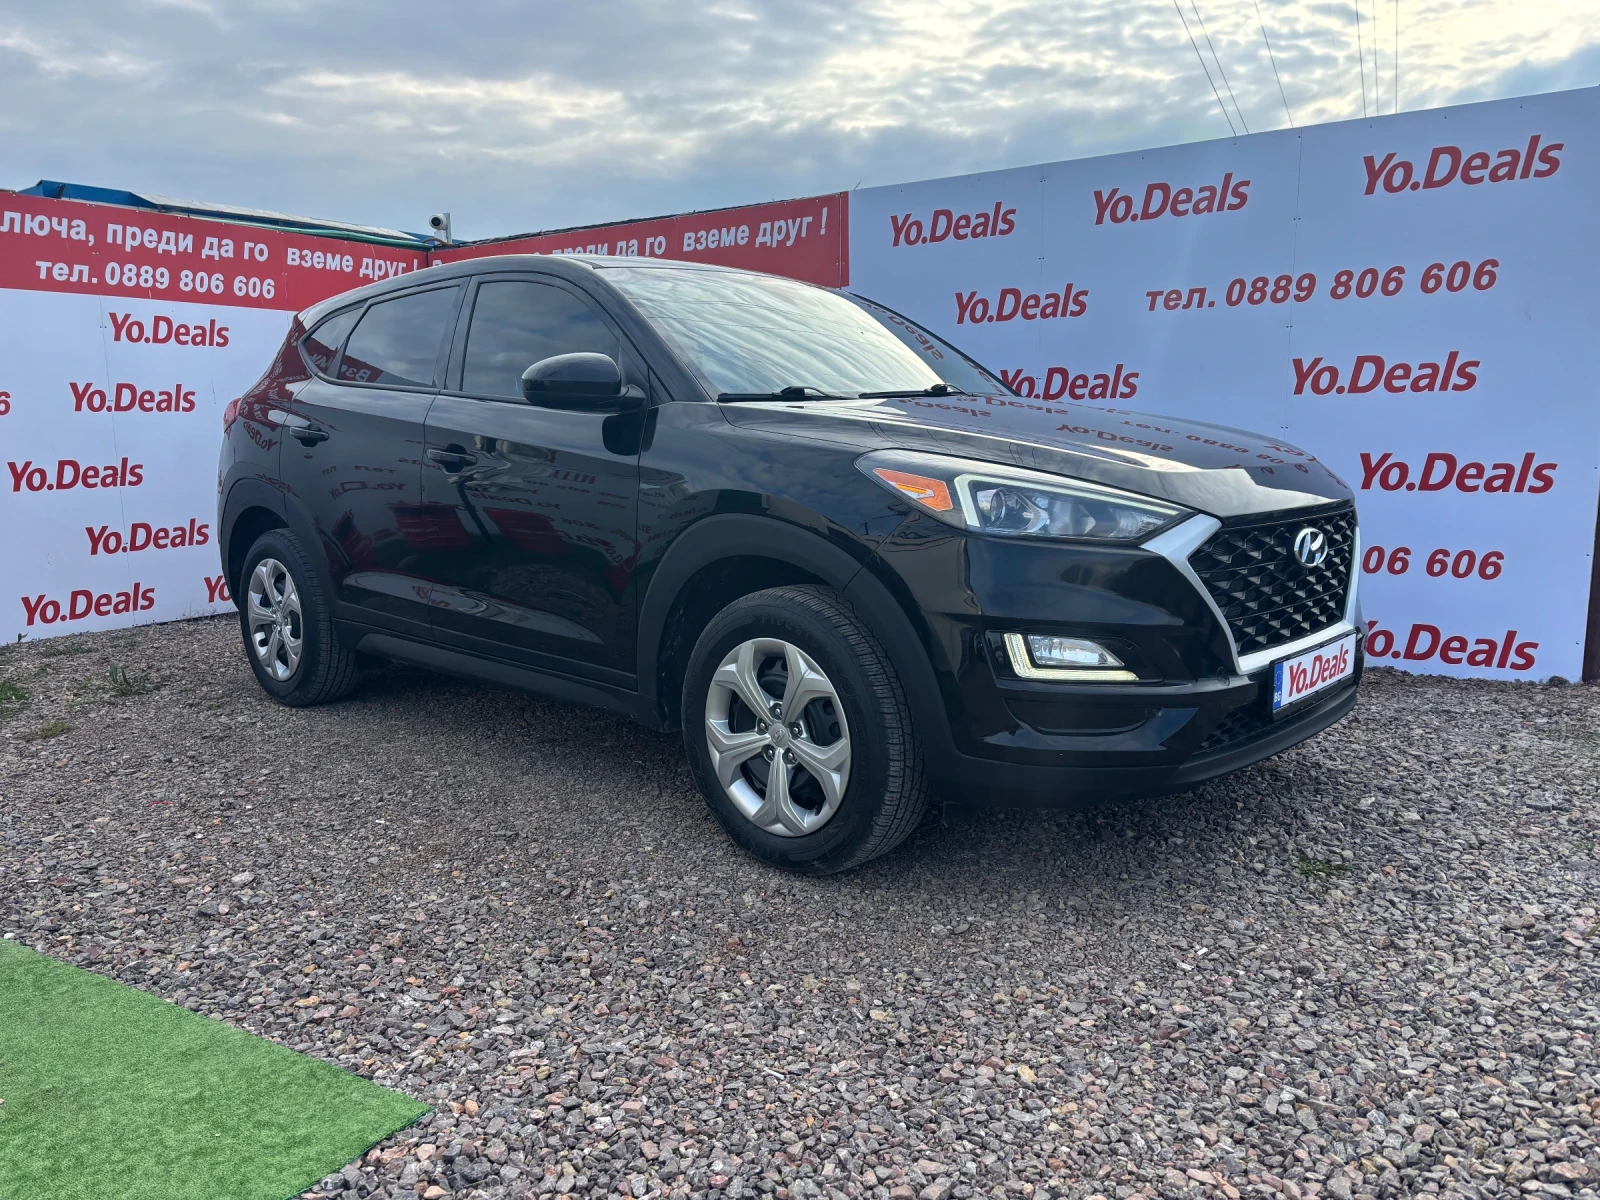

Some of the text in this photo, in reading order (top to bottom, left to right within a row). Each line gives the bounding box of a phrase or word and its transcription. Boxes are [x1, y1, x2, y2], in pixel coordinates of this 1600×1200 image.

[1364, 135, 1563, 195] Yo.Deals
[1094, 174, 1250, 226] Yo.Deals
[645, 235, 667, 256] го
[682, 224, 750, 252] вземе
[755, 216, 813, 248] друг
[820, 207, 828, 235] !
[891, 202, 1016, 247] Yo.Deals
[107, 223, 193, 254] преди
[201, 236, 234, 260] да
[243, 241, 269, 262] го
[287, 247, 354, 273] вземе
[36, 260, 275, 300] тел. 0889 806 606
[1148, 259, 1499, 313] тел. 0889 806 606
[956, 283, 1088, 325] Yo.Deals
[108, 312, 230, 348] Yo.Deals
[1293, 351, 1480, 397] Yo.Deals
[69, 382, 196, 413] Yo.Deals
[7, 457, 143, 493] Yo.Deals
[1360, 452, 1558, 494] Yo.Deals
[85, 518, 209, 556] Yo.Deals
[1426, 548, 1505, 581] 606
[20, 582, 155, 627] Yo.Deals
[1364, 620, 1540, 671] o.Deals
[1288, 643, 1349, 697] Yo.Deals
